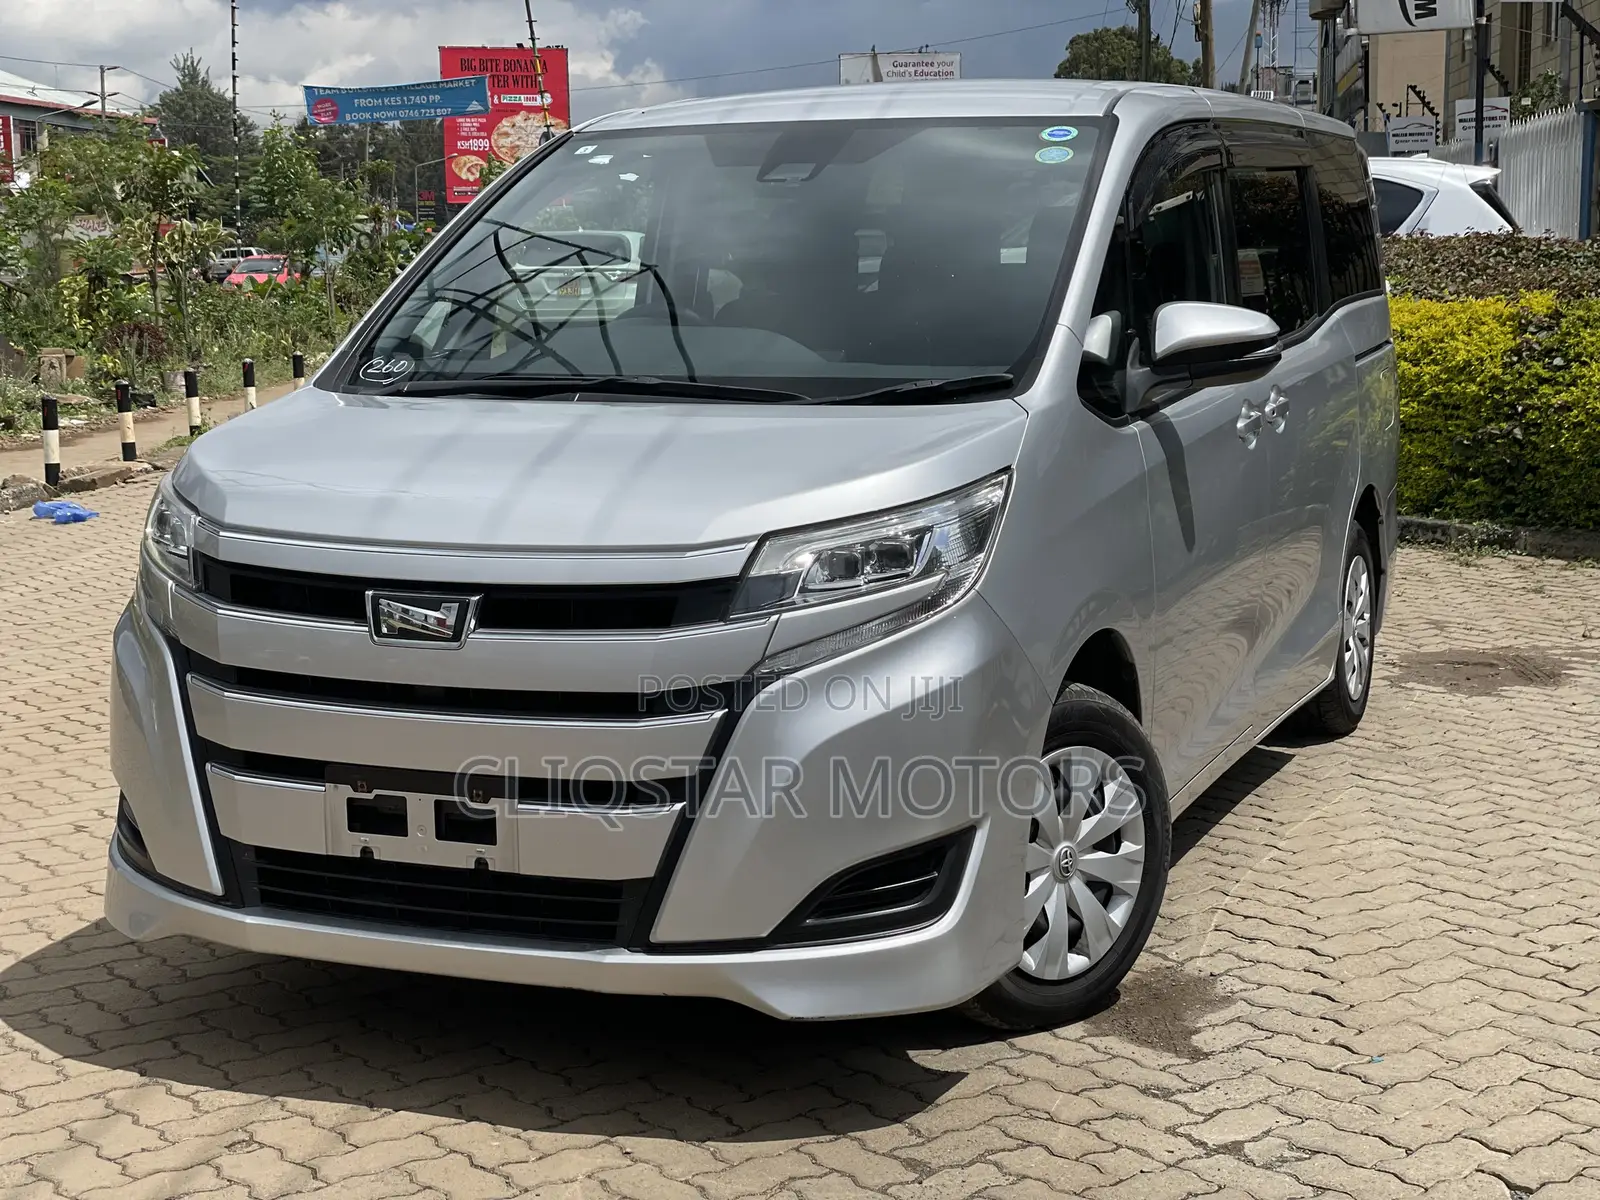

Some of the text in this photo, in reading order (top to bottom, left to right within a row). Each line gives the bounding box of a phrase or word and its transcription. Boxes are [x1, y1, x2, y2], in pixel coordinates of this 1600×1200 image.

[460, 58, 548, 73] BIG BITE BONANA
[892, 60, 954, 69] Guarantee your
[886, 69, 955, 78] Child's Education
[439, 79, 476, 88] MARKET
[512, 74, 538, 88] WITH
[354, 98, 382, 107] FROM
[384, 96, 401, 105] KES
[345, 111, 372, 121] BOOK
[373, 110, 398, 119] NOW!
[398, 109, 419, 118] 0746
[366, 358, 408, 373] 260
